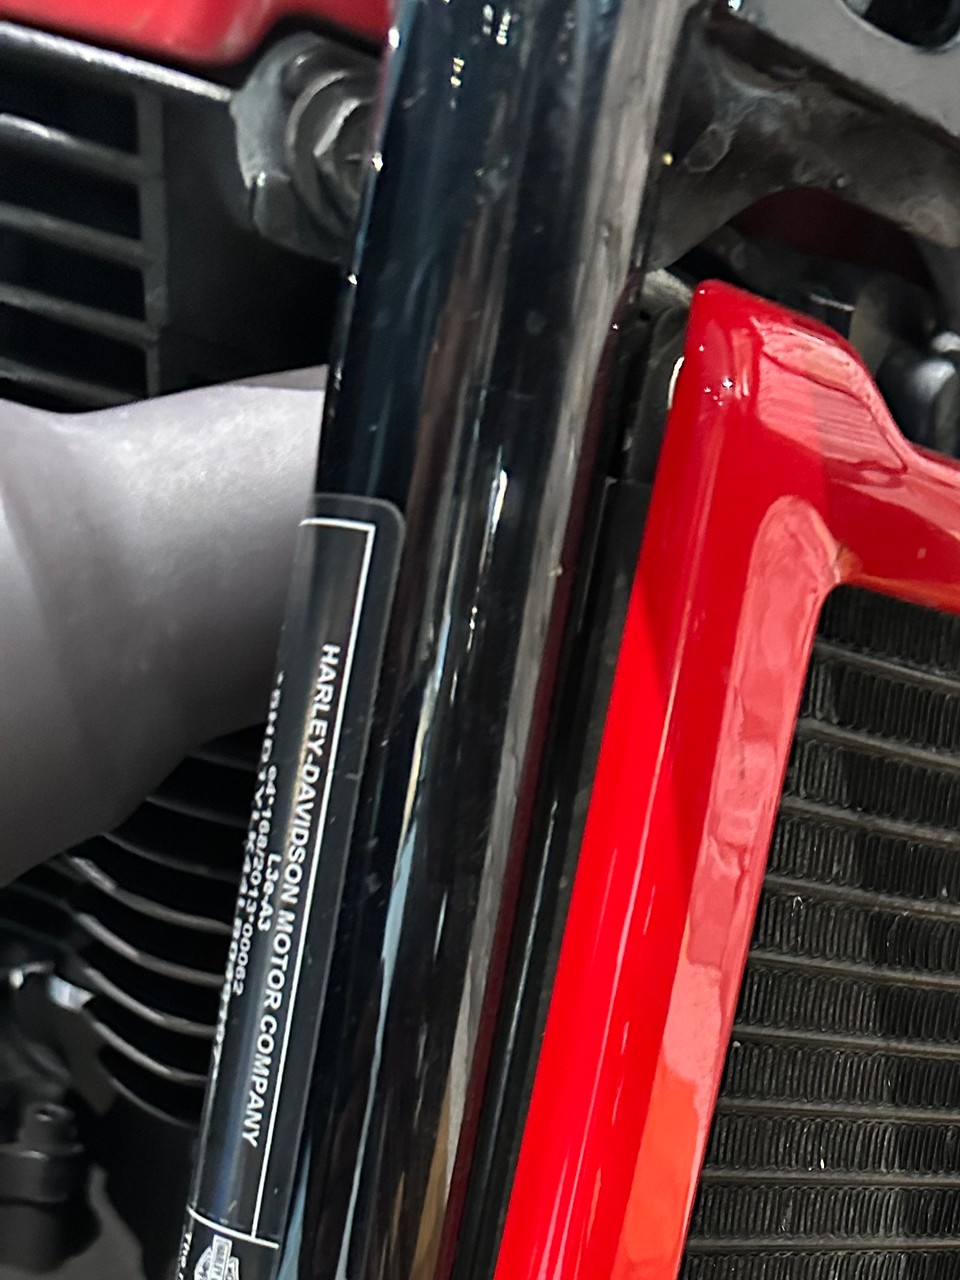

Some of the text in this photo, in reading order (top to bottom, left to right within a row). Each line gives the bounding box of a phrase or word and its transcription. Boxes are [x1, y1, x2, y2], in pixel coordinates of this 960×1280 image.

[241, 644, 341, 1148] HARLEY-DAVIDSON MOTOR COMPANY
[257, 852, 282, 932] L3e-A3
[180, 1233, 192, 1268] The
